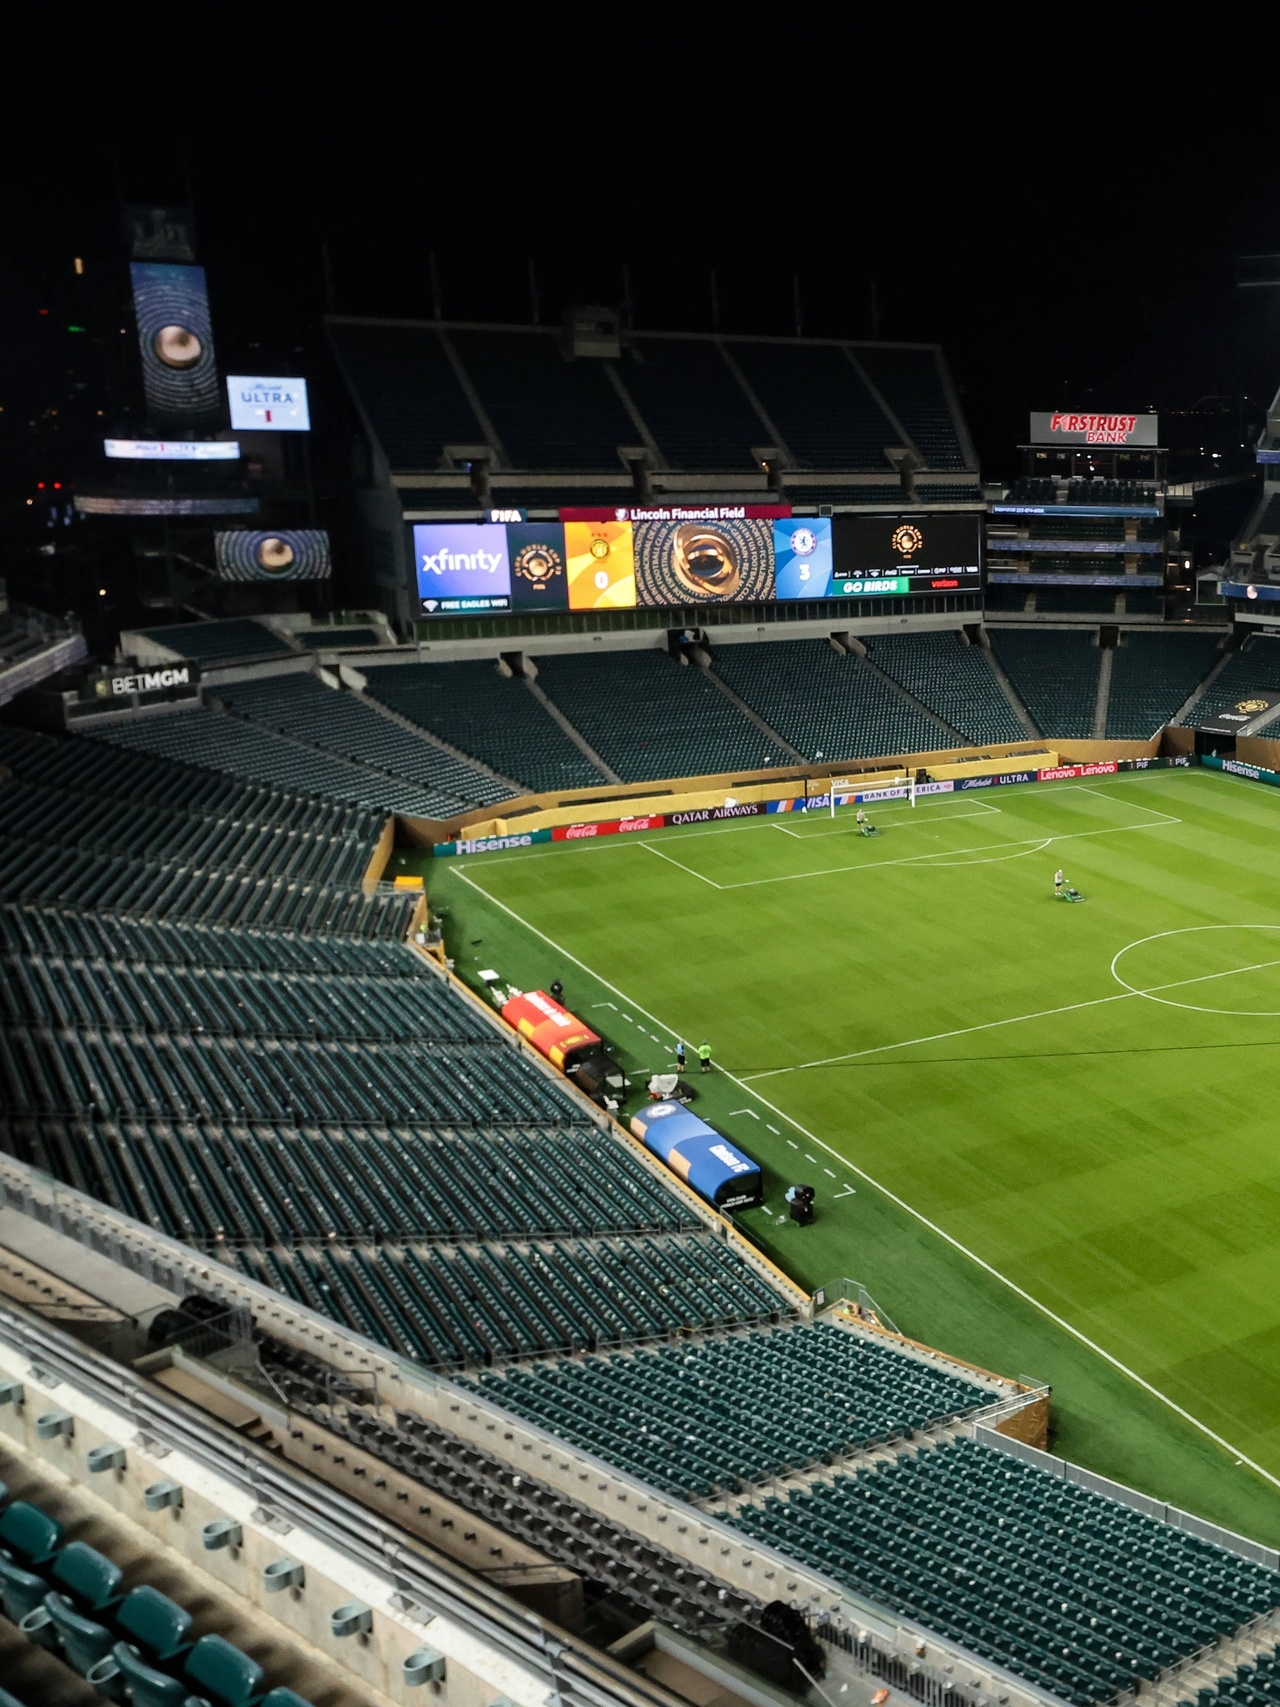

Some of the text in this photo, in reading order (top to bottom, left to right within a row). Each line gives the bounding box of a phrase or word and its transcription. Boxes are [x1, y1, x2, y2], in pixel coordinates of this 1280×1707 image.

[240, 391, 295, 404] ULTRA
[1086, 431, 1127, 444] BANK
[490, 509, 522, 522] FIFA
[630, 507, 745, 520] Lincoln Financial Field
[422, 548, 502, 575] xfinity
[799, 564, 810, 581] 3
[595, 571, 608, 589] 0
[843, 580, 898, 593] GO BIRDS
[931, 578, 959, 588] verizon
[441, 600, 460, 610] FREE
[112, 667, 190, 695] BETMGM
[1081, 764, 1115, 776] Lenovo
[1136, 761, 1149, 769] PIF
[1222, 759, 1259, 780] Hisense
[999, 773, 1029, 785] ULTRA
[1041, 768, 1075, 780] Lenovo
[864, 790, 888, 800] BANK
[890, 788, 901, 797] OF
[802, 795, 831, 809] VISA
[672, 804, 758, 826] QATAR AIRWAYS
[455, 832, 532, 856] Hisense
